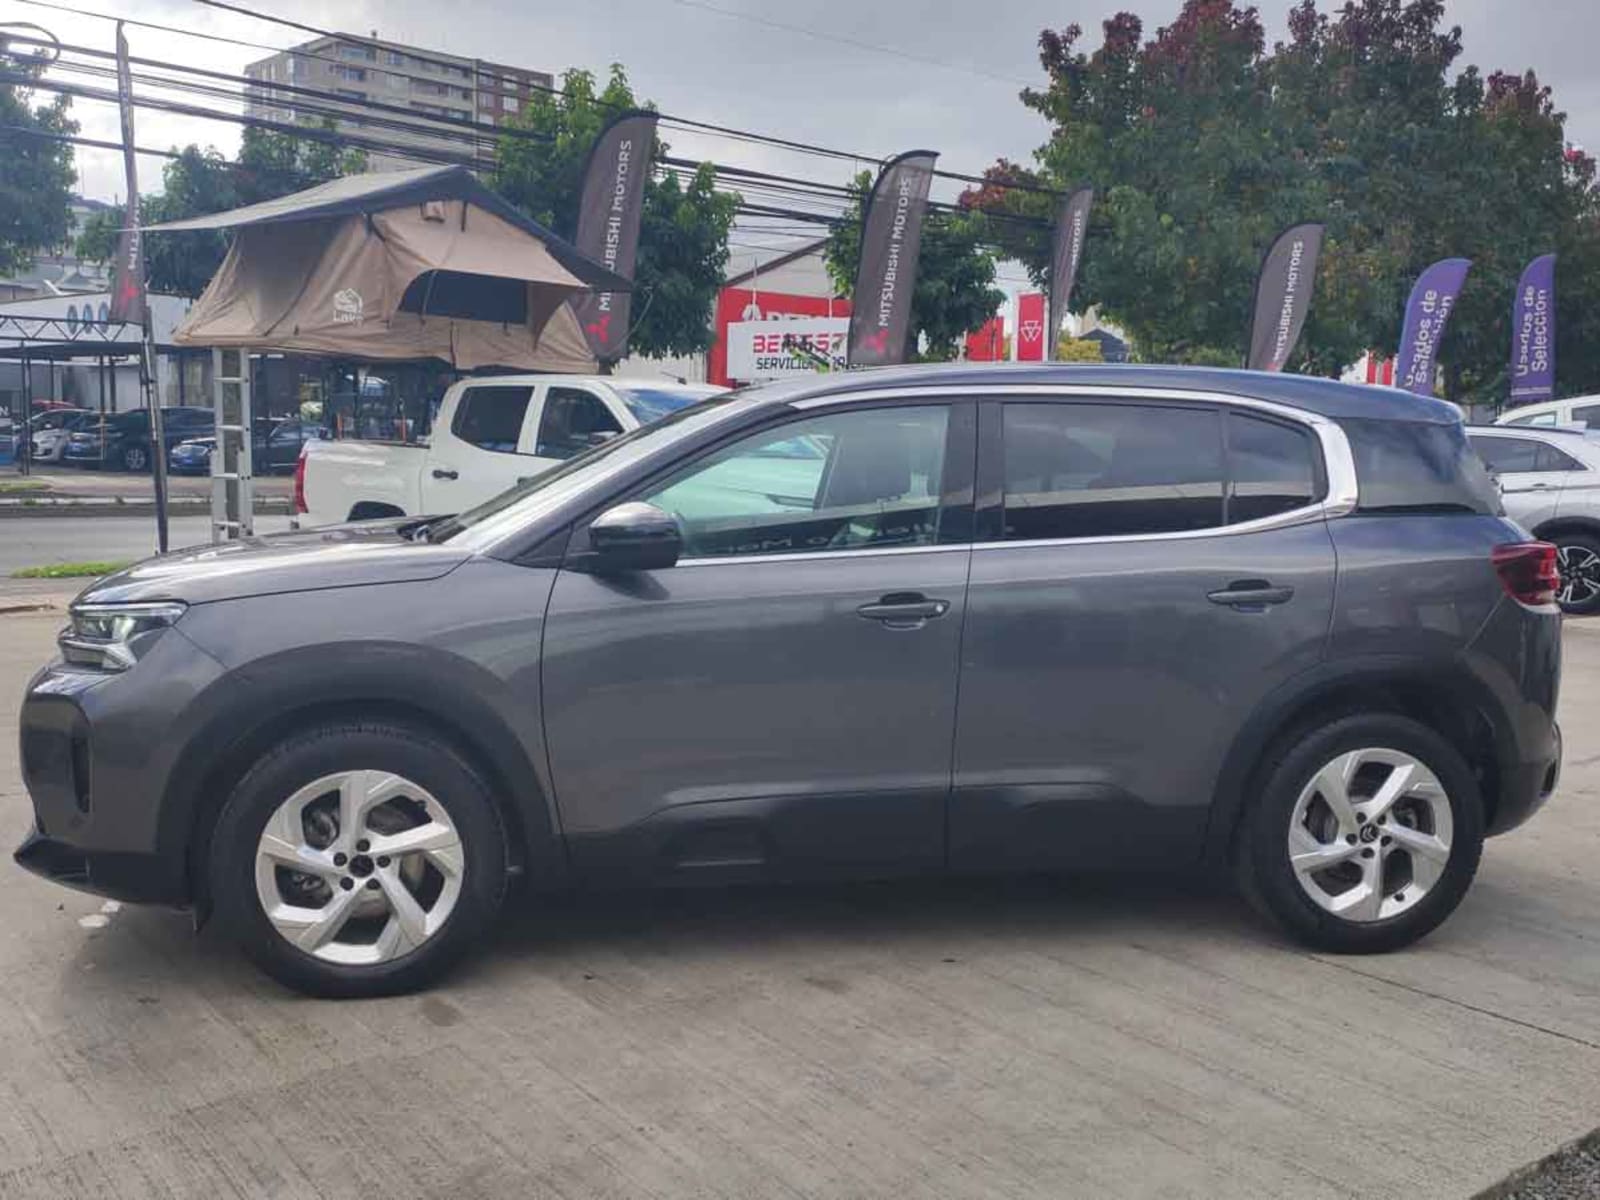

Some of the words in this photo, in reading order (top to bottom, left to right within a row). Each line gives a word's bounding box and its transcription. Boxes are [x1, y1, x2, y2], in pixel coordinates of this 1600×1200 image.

[599, 216, 621, 311] MIUBISHI
[612, 139, 632, 213] MOTORS
[879, 243, 900, 326] MITSUBISHI
[892, 177, 911, 239] MOTORS
[1286, 240, 1304, 292] MOTORS
[1420, 290, 1437, 313] de
[1523, 285, 1535, 307] de
[1515, 312, 1534, 377] Usados
